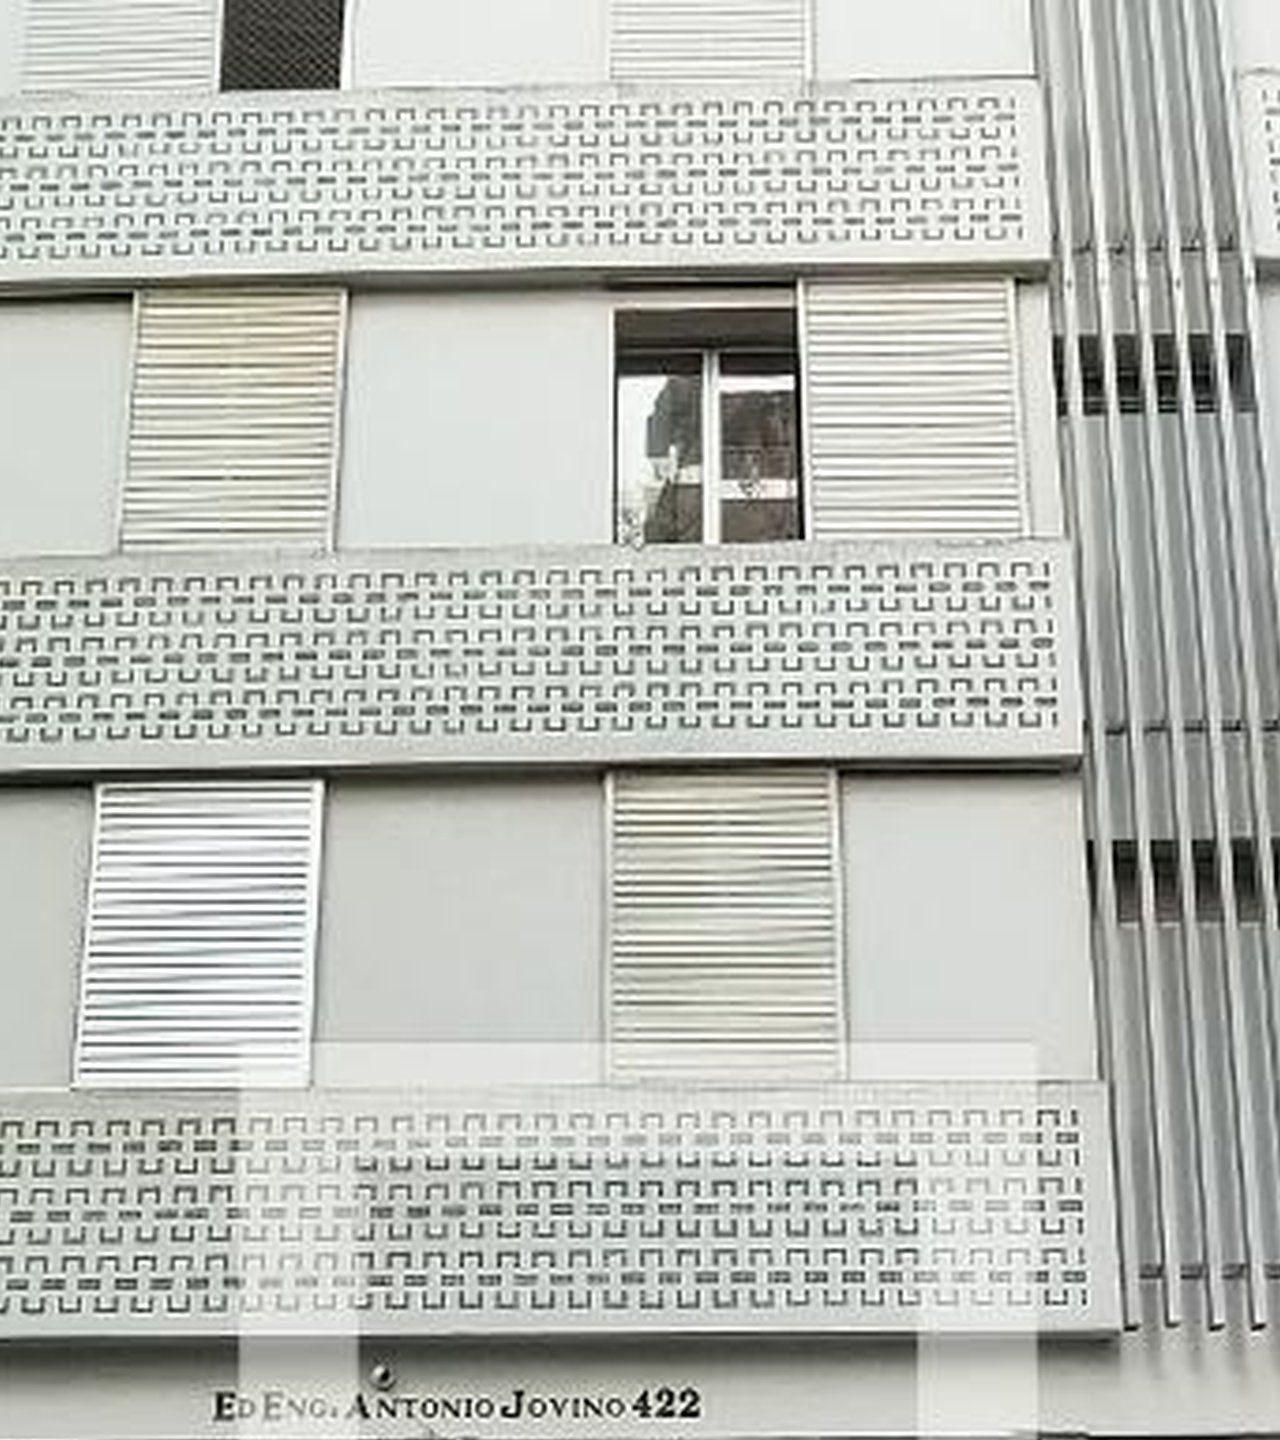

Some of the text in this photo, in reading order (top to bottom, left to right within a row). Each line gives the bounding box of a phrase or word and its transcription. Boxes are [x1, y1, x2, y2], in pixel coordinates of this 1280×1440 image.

[345, 1393, 494, 1418] ANTONIO
[500, 1390, 625, 1418] JOVINO
[631, 1387, 700, 1418] 422
